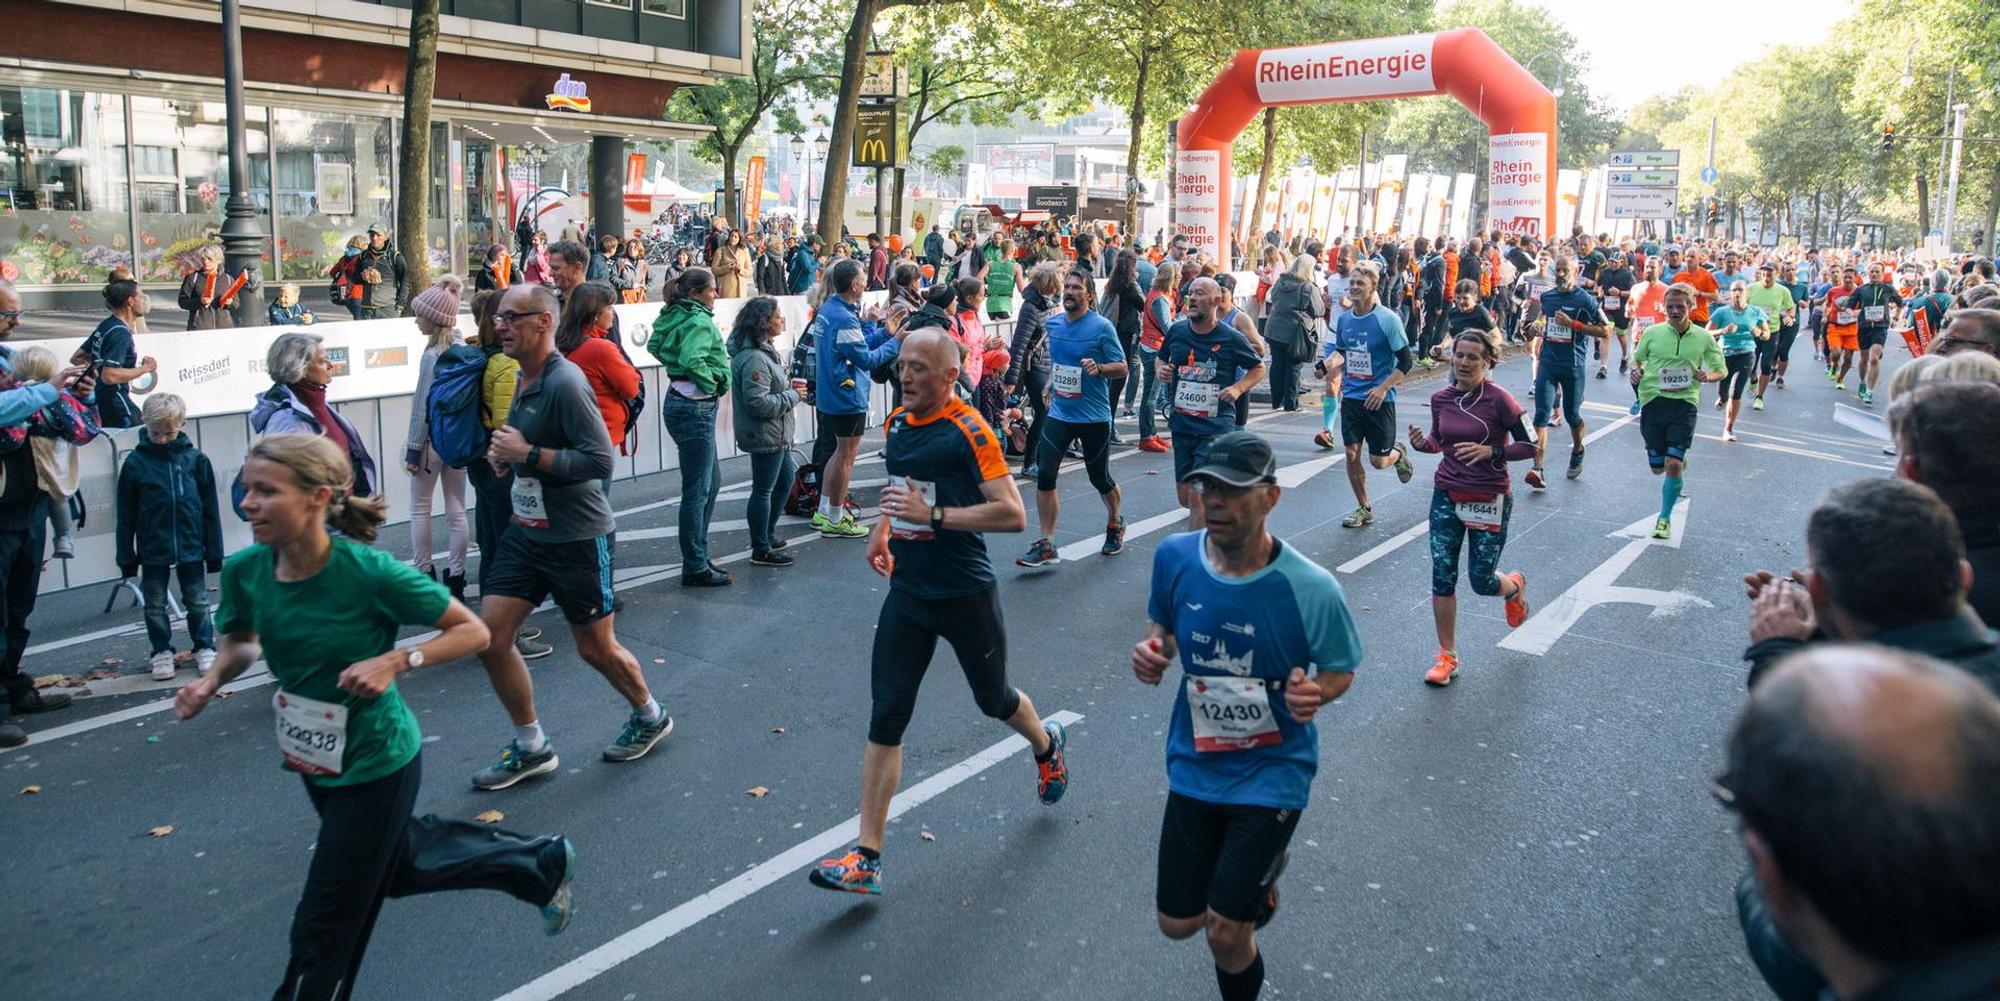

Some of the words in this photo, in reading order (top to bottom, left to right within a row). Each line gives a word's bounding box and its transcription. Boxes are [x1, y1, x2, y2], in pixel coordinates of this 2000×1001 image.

[1260, 50, 1426, 83] RheinEnergie
[554, 73, 587, 97] dm
[1494, 160, 1532, 172] Rhein
[1491, 172, 1542, 187] Energie
[1493, 219, 1515, 231] Rhe
[178, 354, 231, 381] Reissdorf
[1054, 373, 1078, 386] 23289
[1179, 391, 1207, 403] 24600
[1460, 502, 1498, 515] F16441
[1200, 702, 1262, 721] 12430
